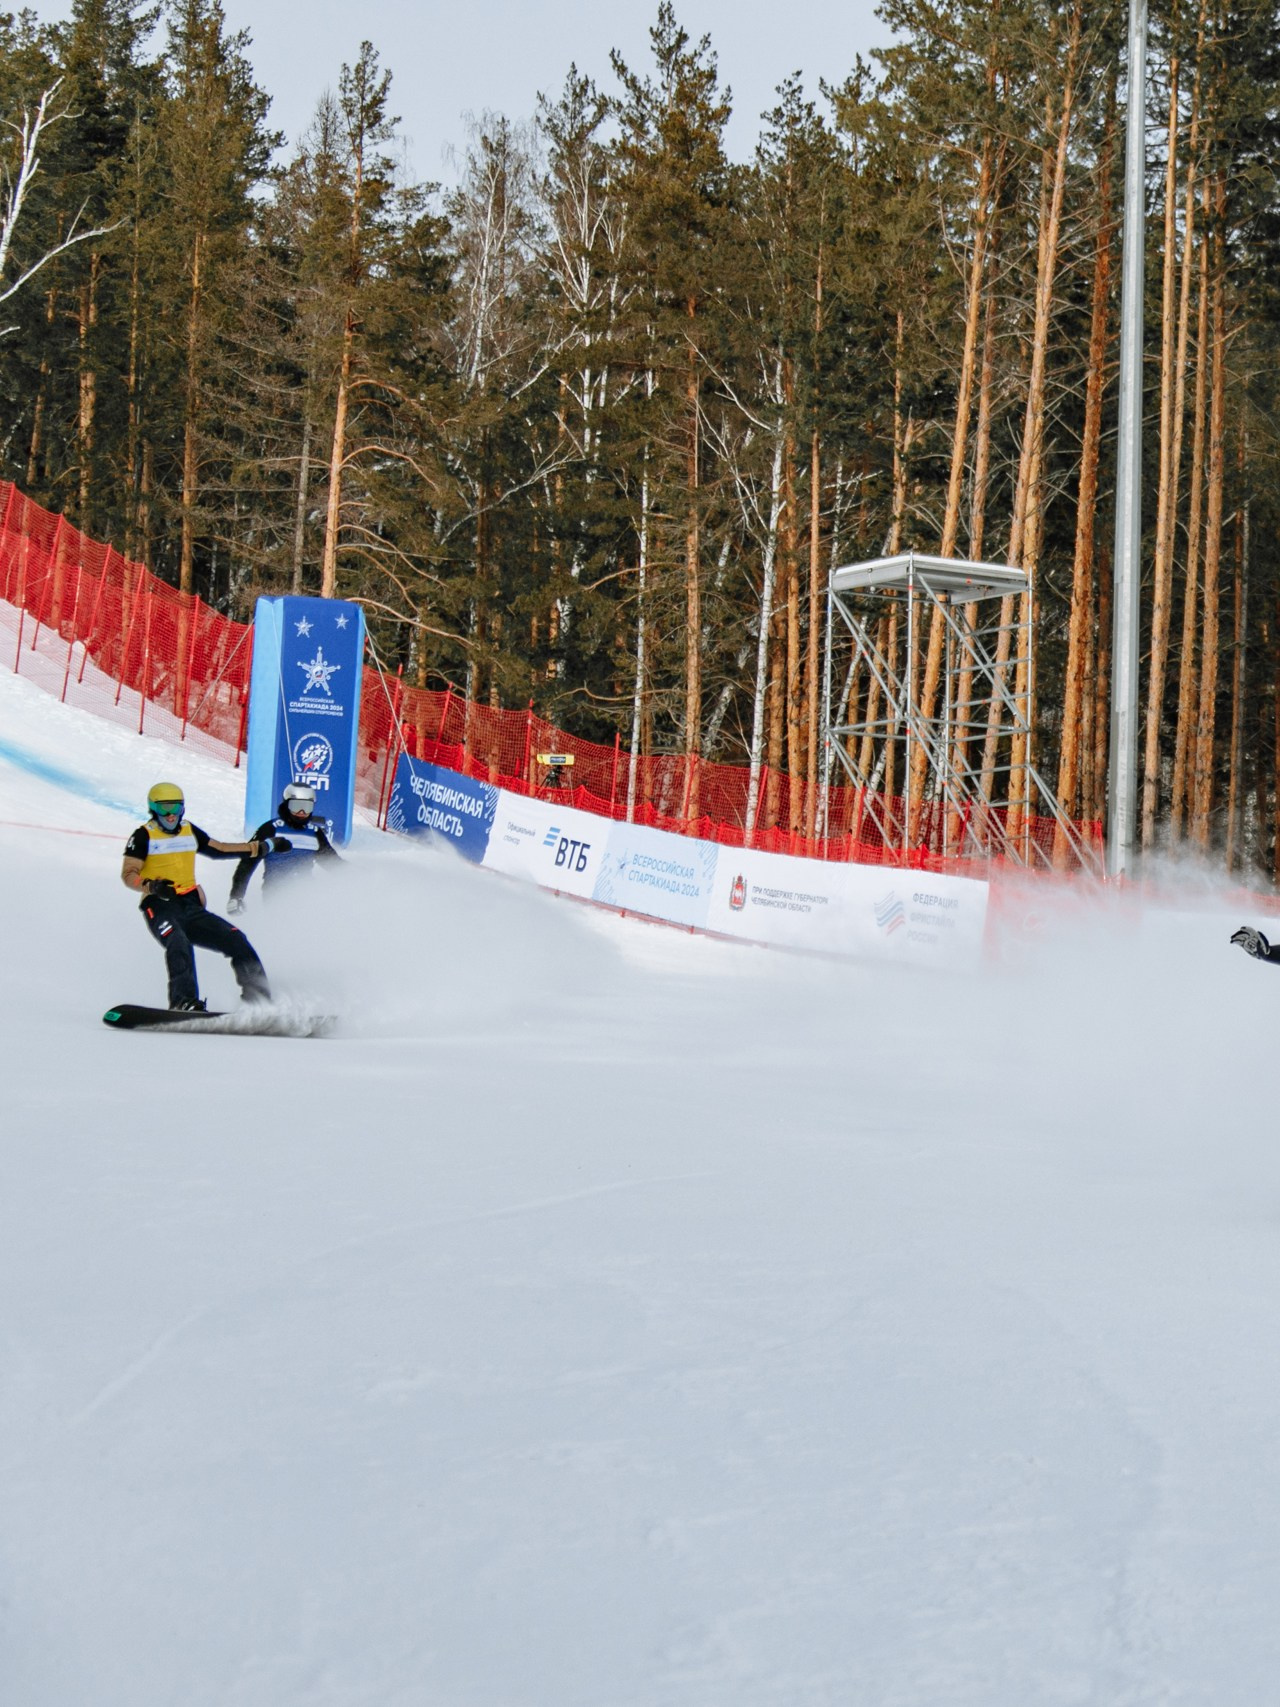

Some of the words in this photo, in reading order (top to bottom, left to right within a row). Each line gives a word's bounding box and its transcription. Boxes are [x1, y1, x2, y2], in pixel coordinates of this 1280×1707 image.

[289, 701, 329, 710] СПАРТАКИАДА
[410, 774, 484, 819] ЧЕЛЯБИНСКАЯ
[417, 804, 464, 837] ОБЛАСТЬ
[554, 836, 591, 873] ВТБ
[632, 853, 695, 880] ВСЕРОССИЙСКАЯ
[628, 869, 681, 893] СПАРТАКИАДА
[681, 883, 700, 898] 2024
[752, 885, 763, 895] ПРИ
[912, 892, 959, 910] ФЕДЕРАЦИЯ
